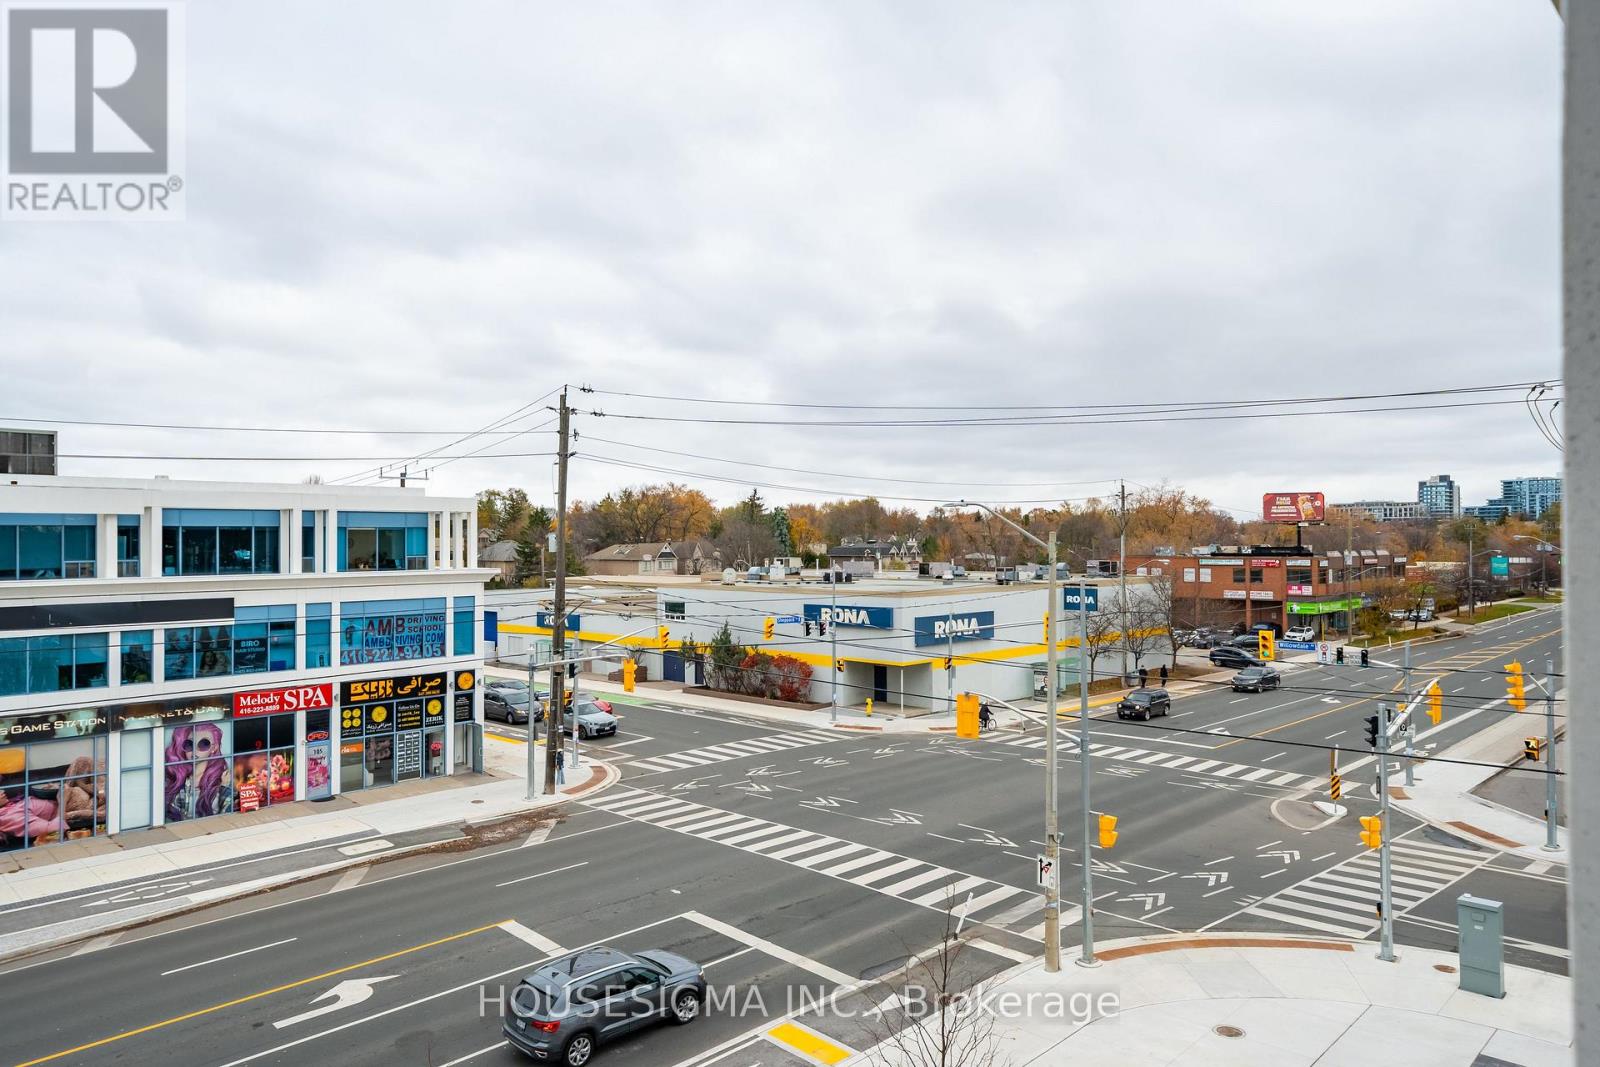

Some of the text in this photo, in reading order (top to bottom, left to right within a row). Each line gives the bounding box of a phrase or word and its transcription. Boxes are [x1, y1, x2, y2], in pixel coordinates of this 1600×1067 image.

[543, 615, 569, 628] RO
[821, 607, 871, 625] RONA
[367, 615, 405, 636] AMB
[934, 617, 980, 639] RONA
[365, 633, 445, 649] AMBDRIVINGCOM
[240, 687, 328, 710] Melody SPA
[240, 790, 257, 798] SPA
